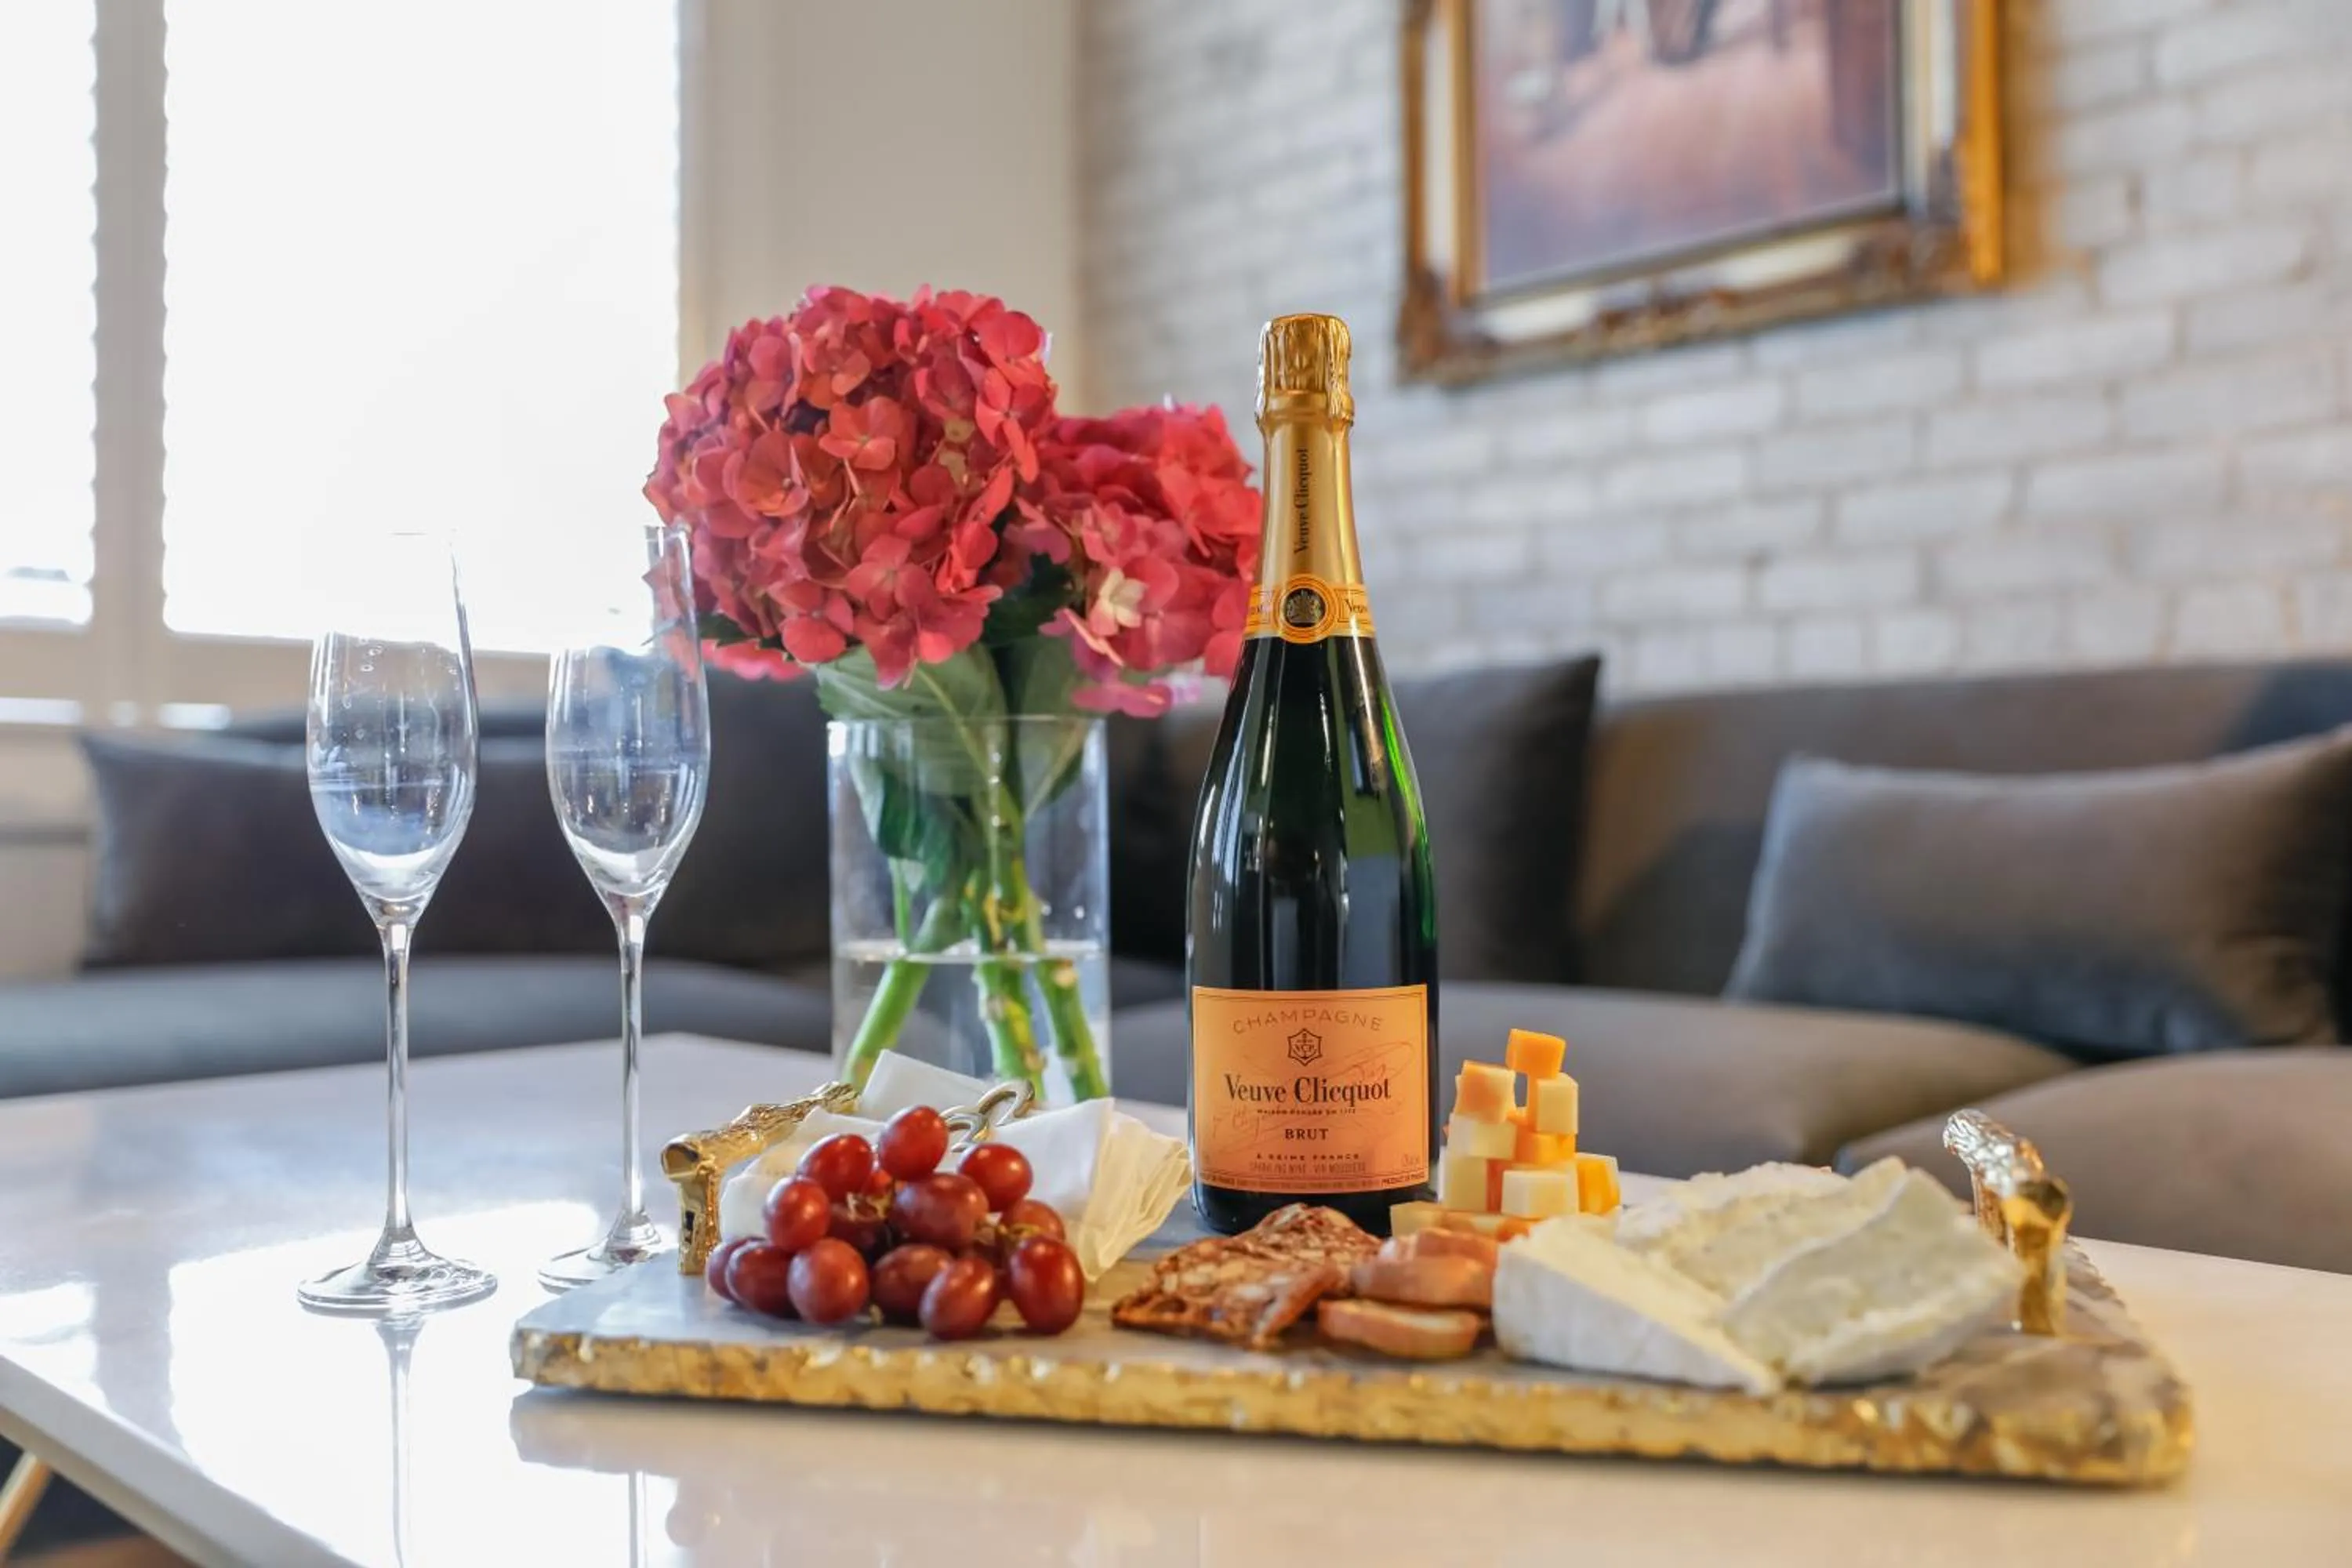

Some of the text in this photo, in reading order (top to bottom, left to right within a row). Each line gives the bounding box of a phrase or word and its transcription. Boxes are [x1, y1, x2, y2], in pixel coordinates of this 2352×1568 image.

[1294, 448, 1312, 554] Veuve Clicquot
[1232, 1009, 1383, 1035] CHAMPAGNE
[1224, 1073, 1391, 1108] Veuve Clicquot
[1284, 1128, 1329, 1140] BRUT
